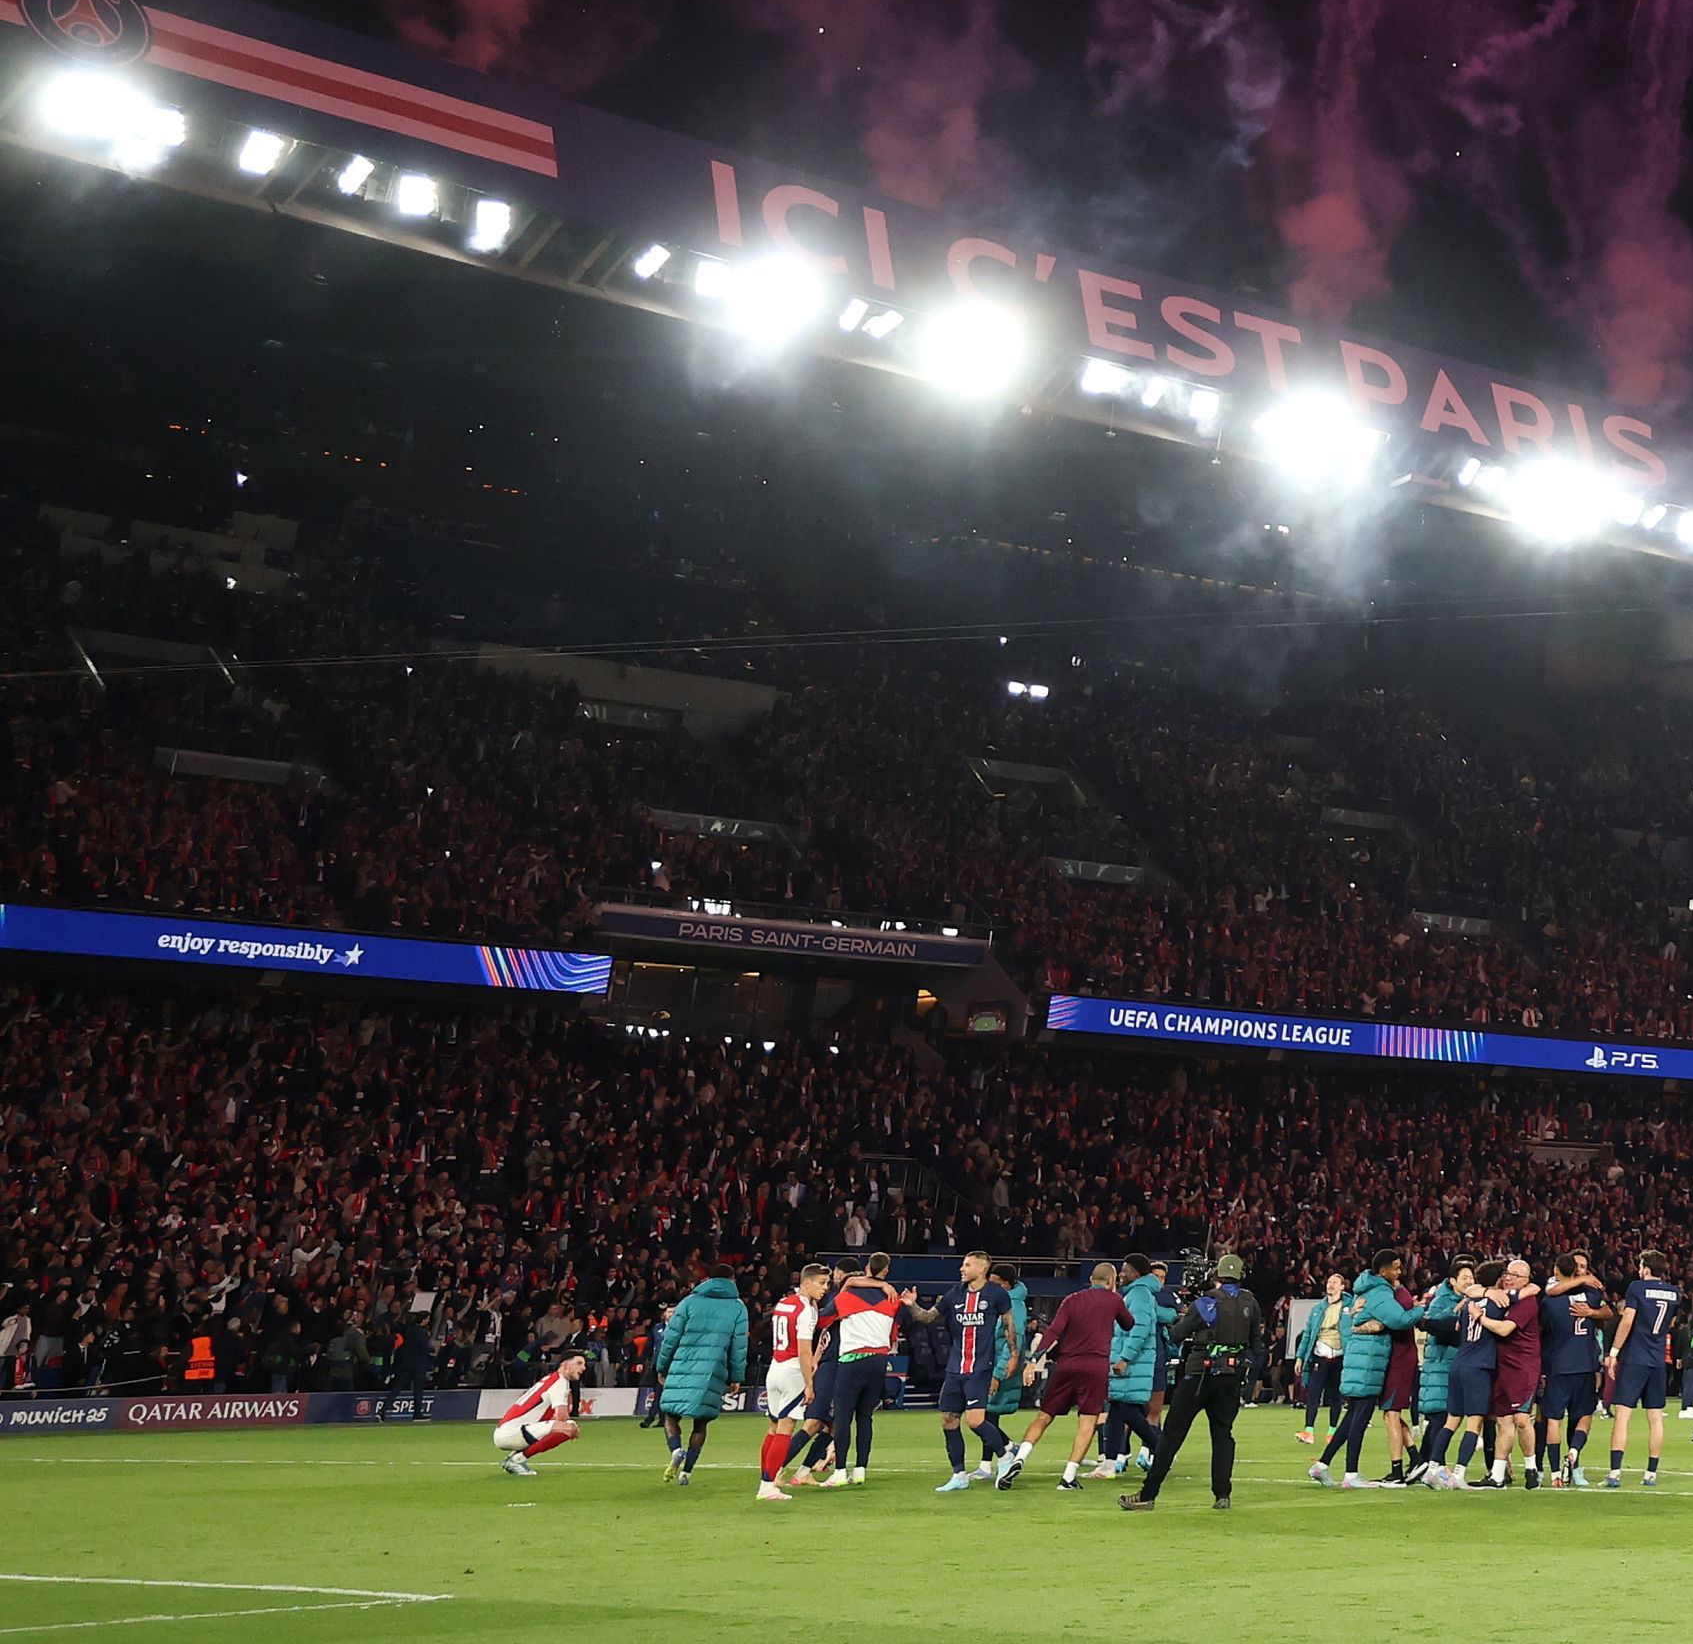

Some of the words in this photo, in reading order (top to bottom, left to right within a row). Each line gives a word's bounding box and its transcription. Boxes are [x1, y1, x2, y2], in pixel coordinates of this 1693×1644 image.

[711, 160, 896, 290] ICI
[1340, 340, 1668, 488] PARIS
[158, 931, 214, 955] enjoy
[217, 938, 334, 965] responsibly
[678, 923, 743, 945] PARIS
[750, 926, 917, 958] SAINT-GERMAIN
[1108, 1008, 1158, 1032] UEFA
[1163, 1013, 1277, 1042] CHAMPIONS
[1280, 1020, 1351, 1046] LEAGUE
[1611, 1051, 1657, 1069] PS5
[773, 1314, 789, 1351] 19
[956, 1312, 984, 1324] QATAR
[1652, 1300, 1668, 1335] 7
[128, 1403, 202, 1425] QATAR
[207, 1400, 299, 1419] AIRWAYS
[375, 1399, 434, 1415] RSPET
